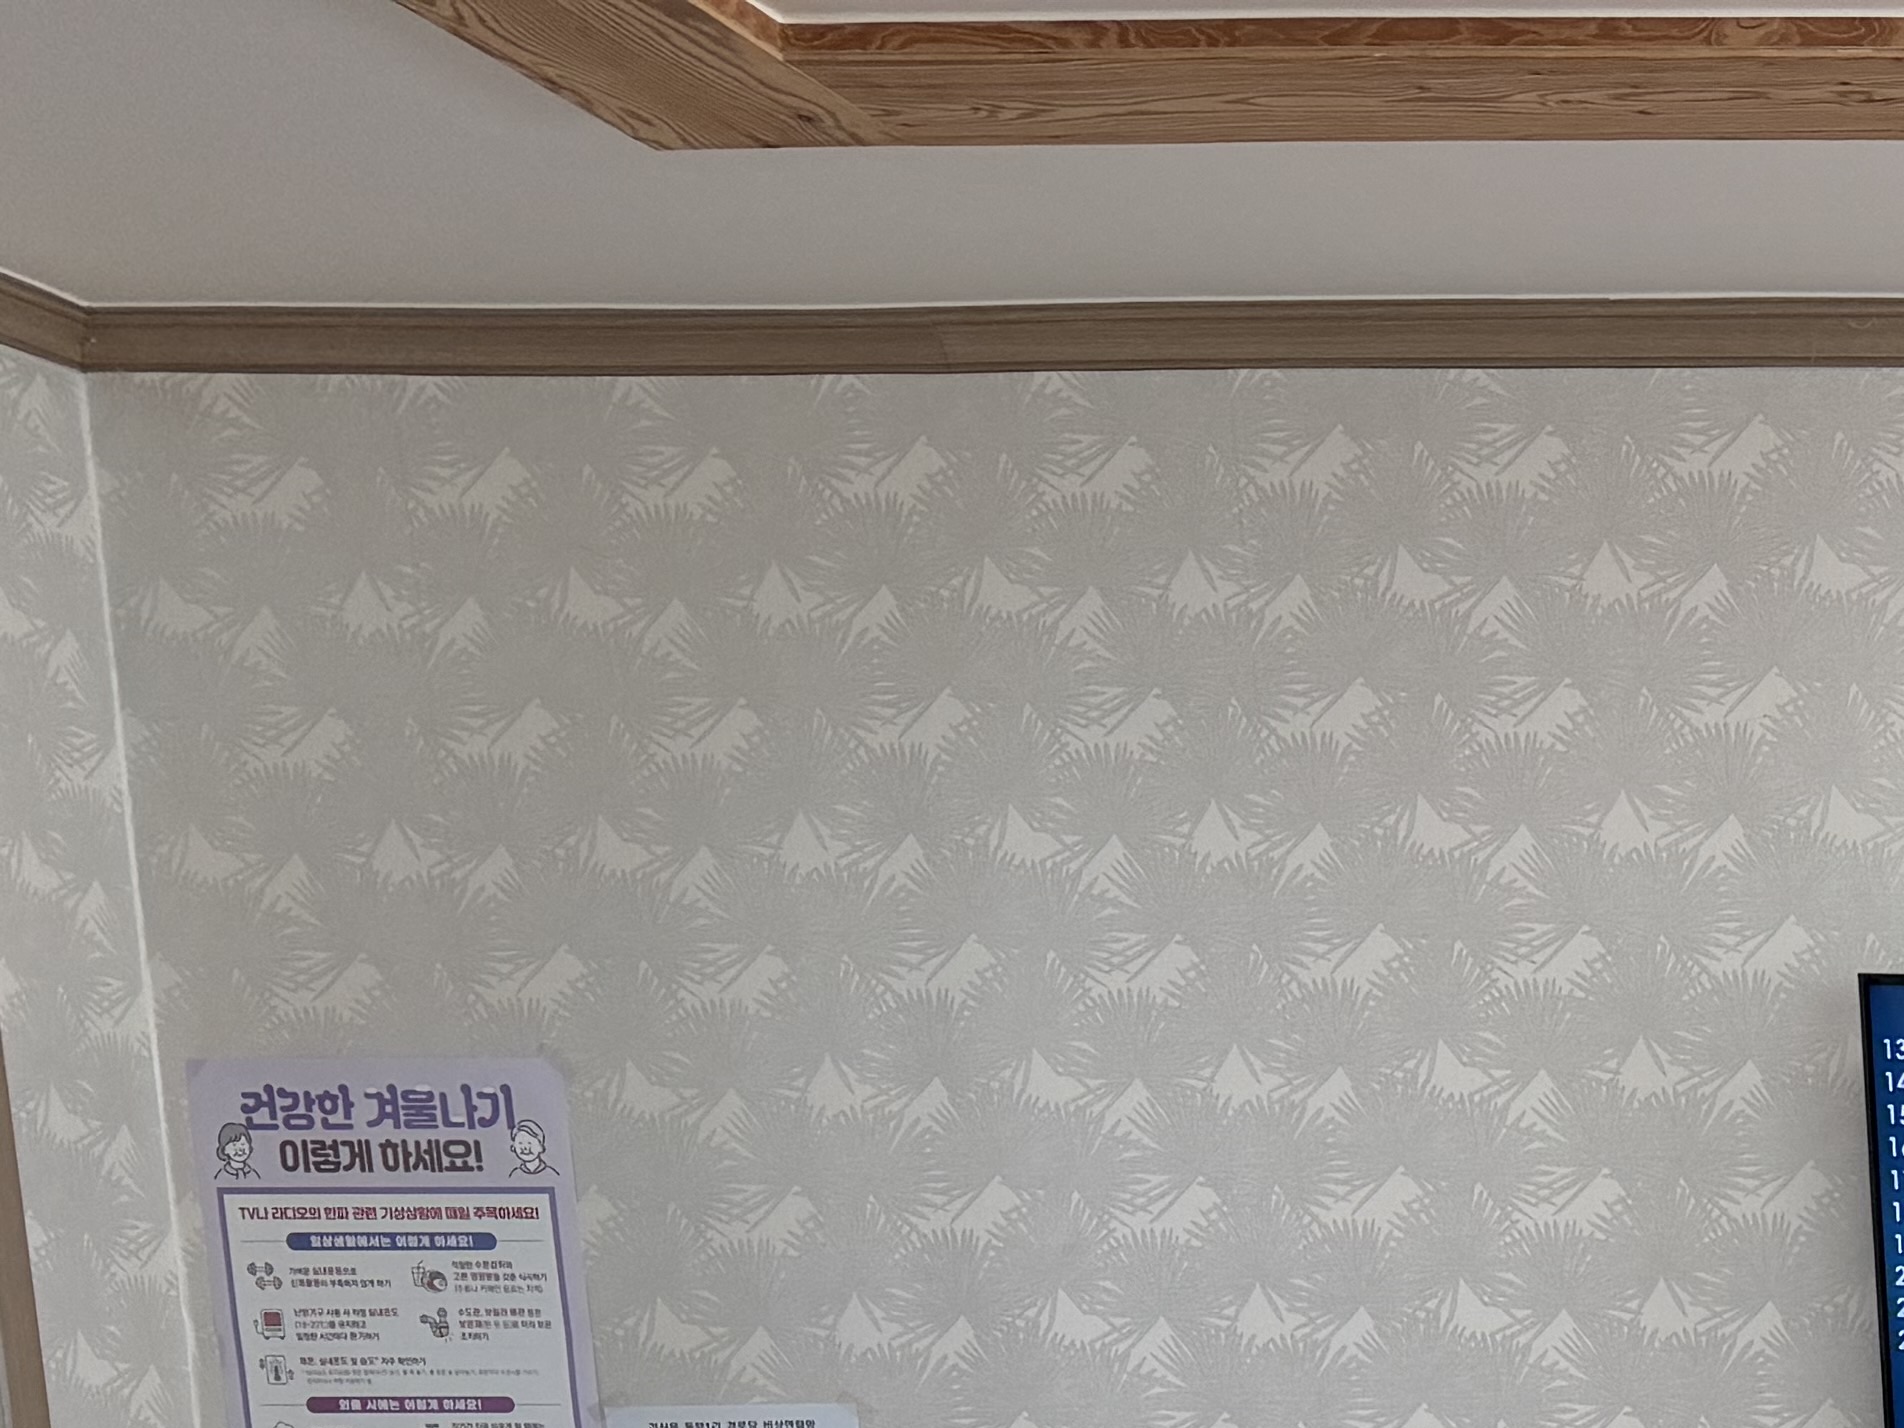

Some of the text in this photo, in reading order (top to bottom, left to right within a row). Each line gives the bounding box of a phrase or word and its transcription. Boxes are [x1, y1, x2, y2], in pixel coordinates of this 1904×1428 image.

[240, 1083, 516, 1131] 건강한 겨울나기
[279, 1138, 484, 1173] 이렇게 하세요!
